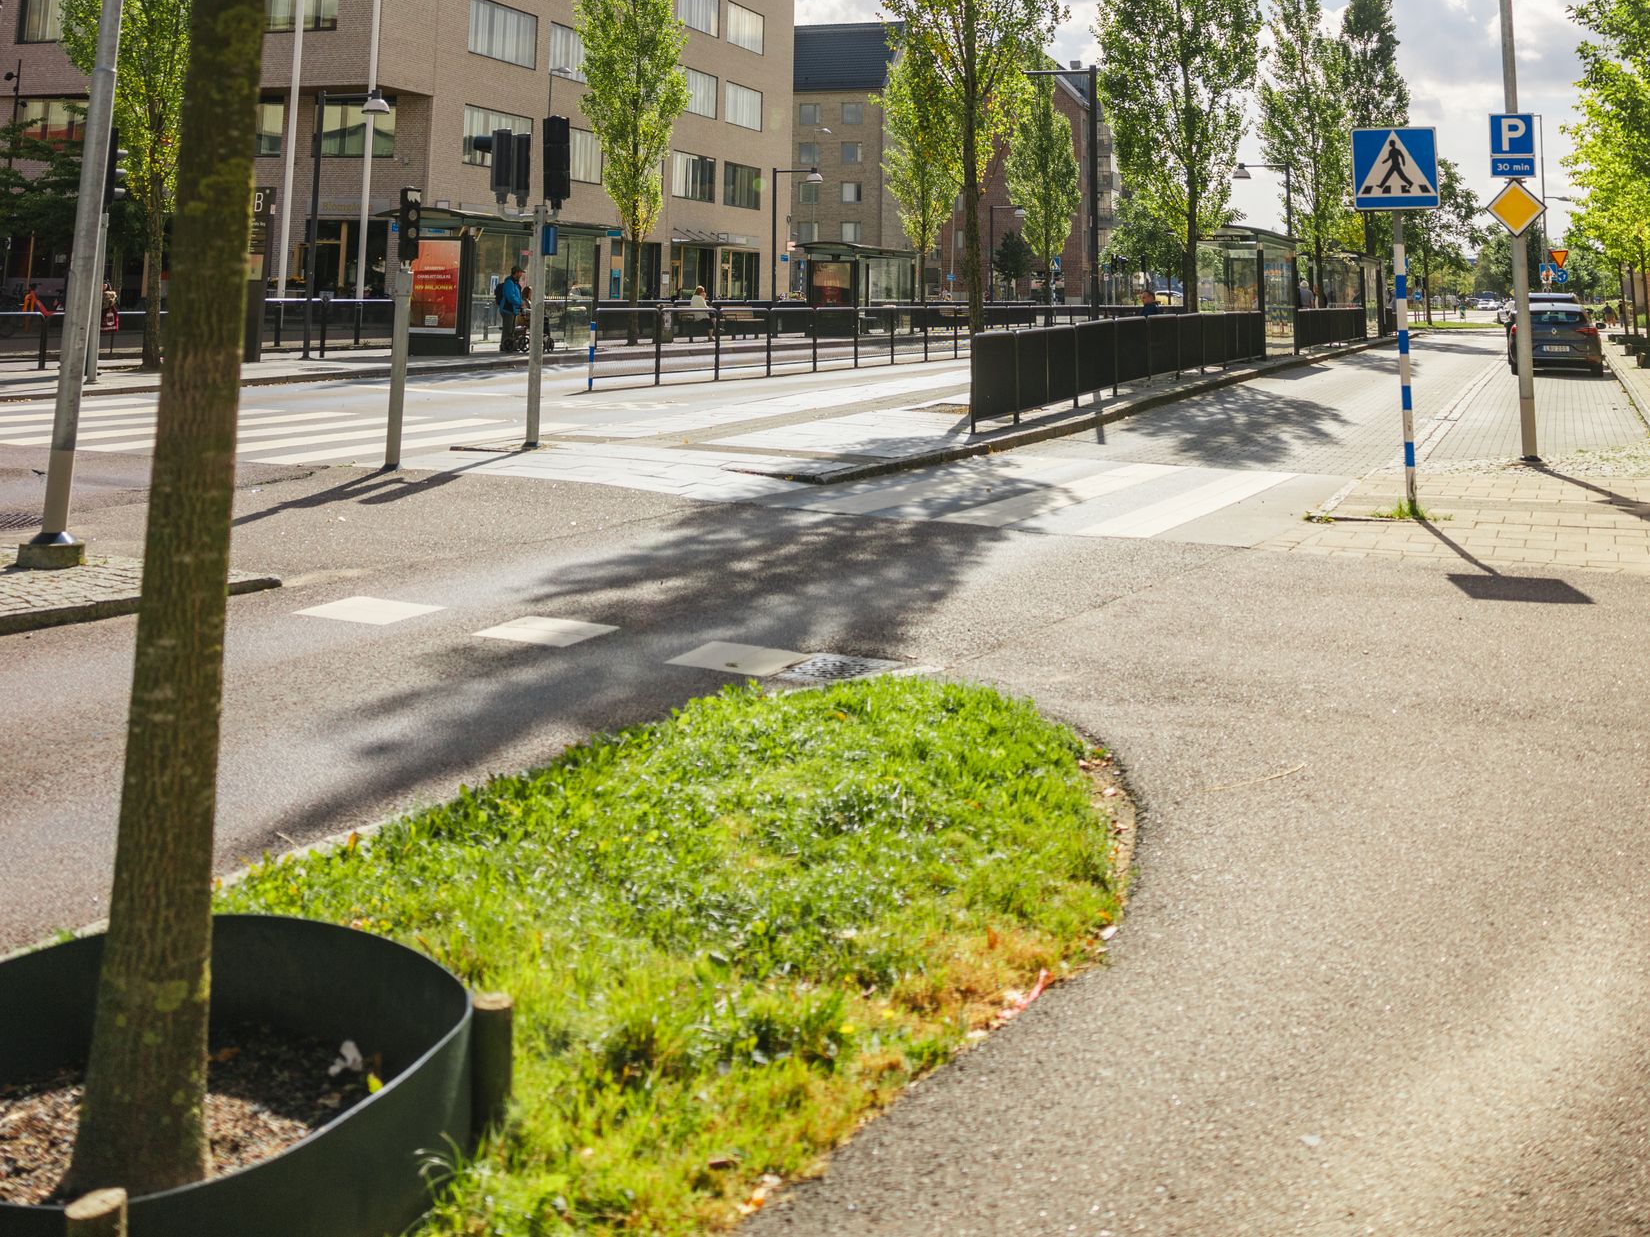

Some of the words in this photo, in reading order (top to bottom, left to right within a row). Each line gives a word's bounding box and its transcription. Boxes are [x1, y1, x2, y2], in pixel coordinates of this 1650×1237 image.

[1501, 118, 1526, 152] P
[1496, 163, 1510, 171] 30
[1513, 163, 1530, 171] min
[254, 192, 264, 213] B
